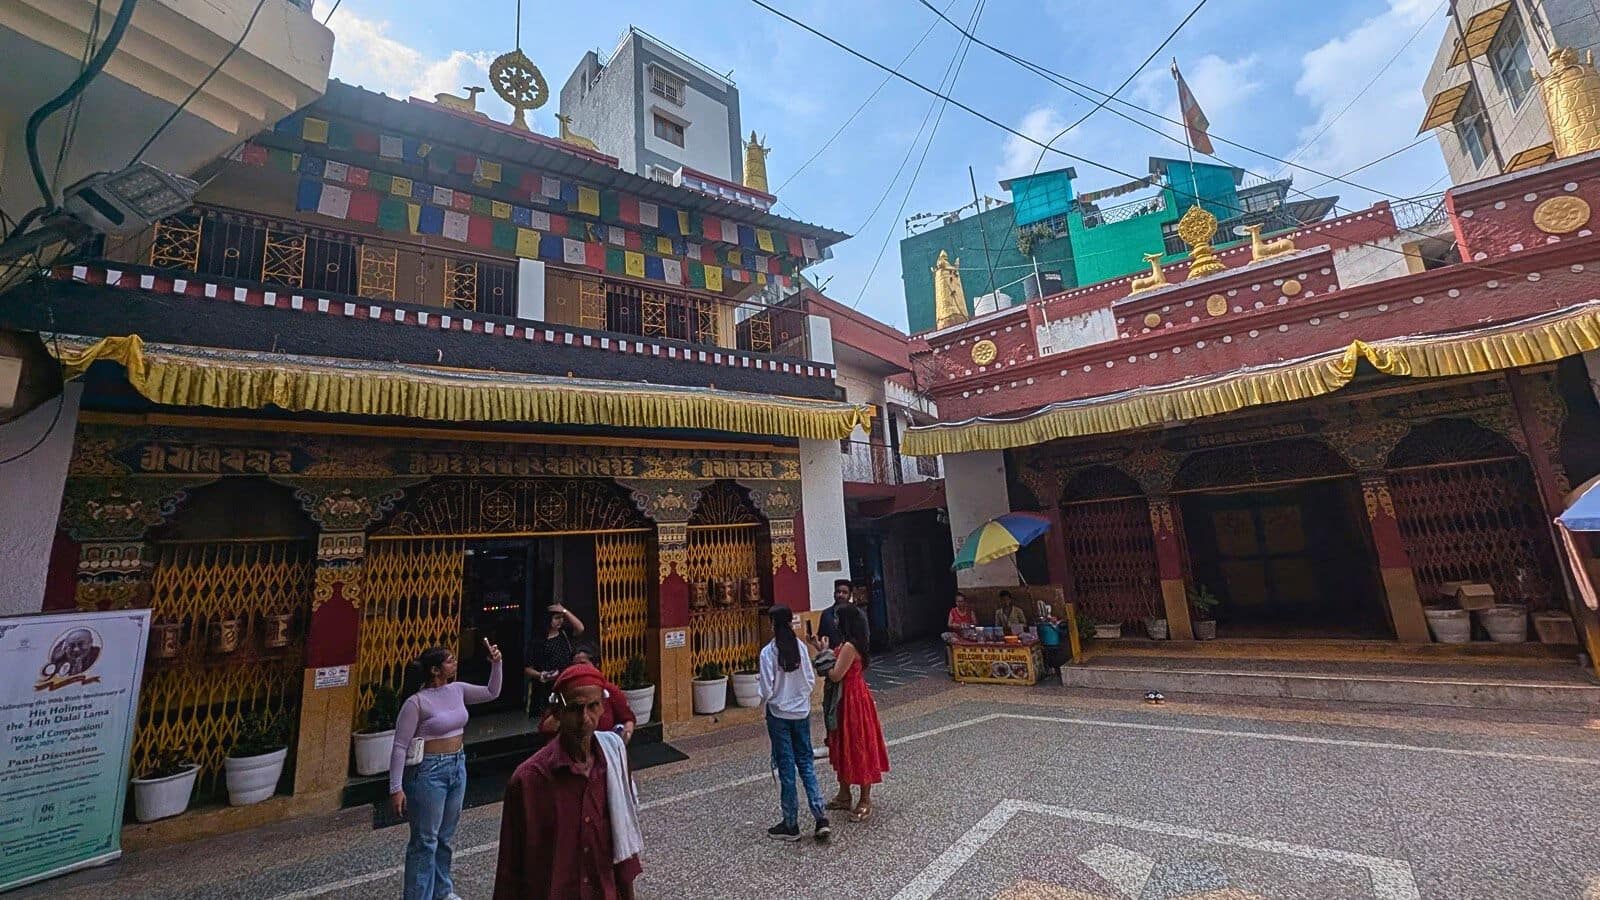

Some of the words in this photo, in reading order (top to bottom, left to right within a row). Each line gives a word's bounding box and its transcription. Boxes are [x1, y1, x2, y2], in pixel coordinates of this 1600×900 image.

[29, 709, 47, 718] His
[49, 703, 92, 715] Holiness
[6, 721, 24, 731] the
[28, 717, 51, 728] 14th
[54, 714, 81, 723] Dalai
[83, 709, 109, 719] Lama
[36, 730, 45, 739] of
[8, 756, 39, 768] Panel
[41, 746, 97, 760] Discussion
[41, 803, 55, 814] 06
